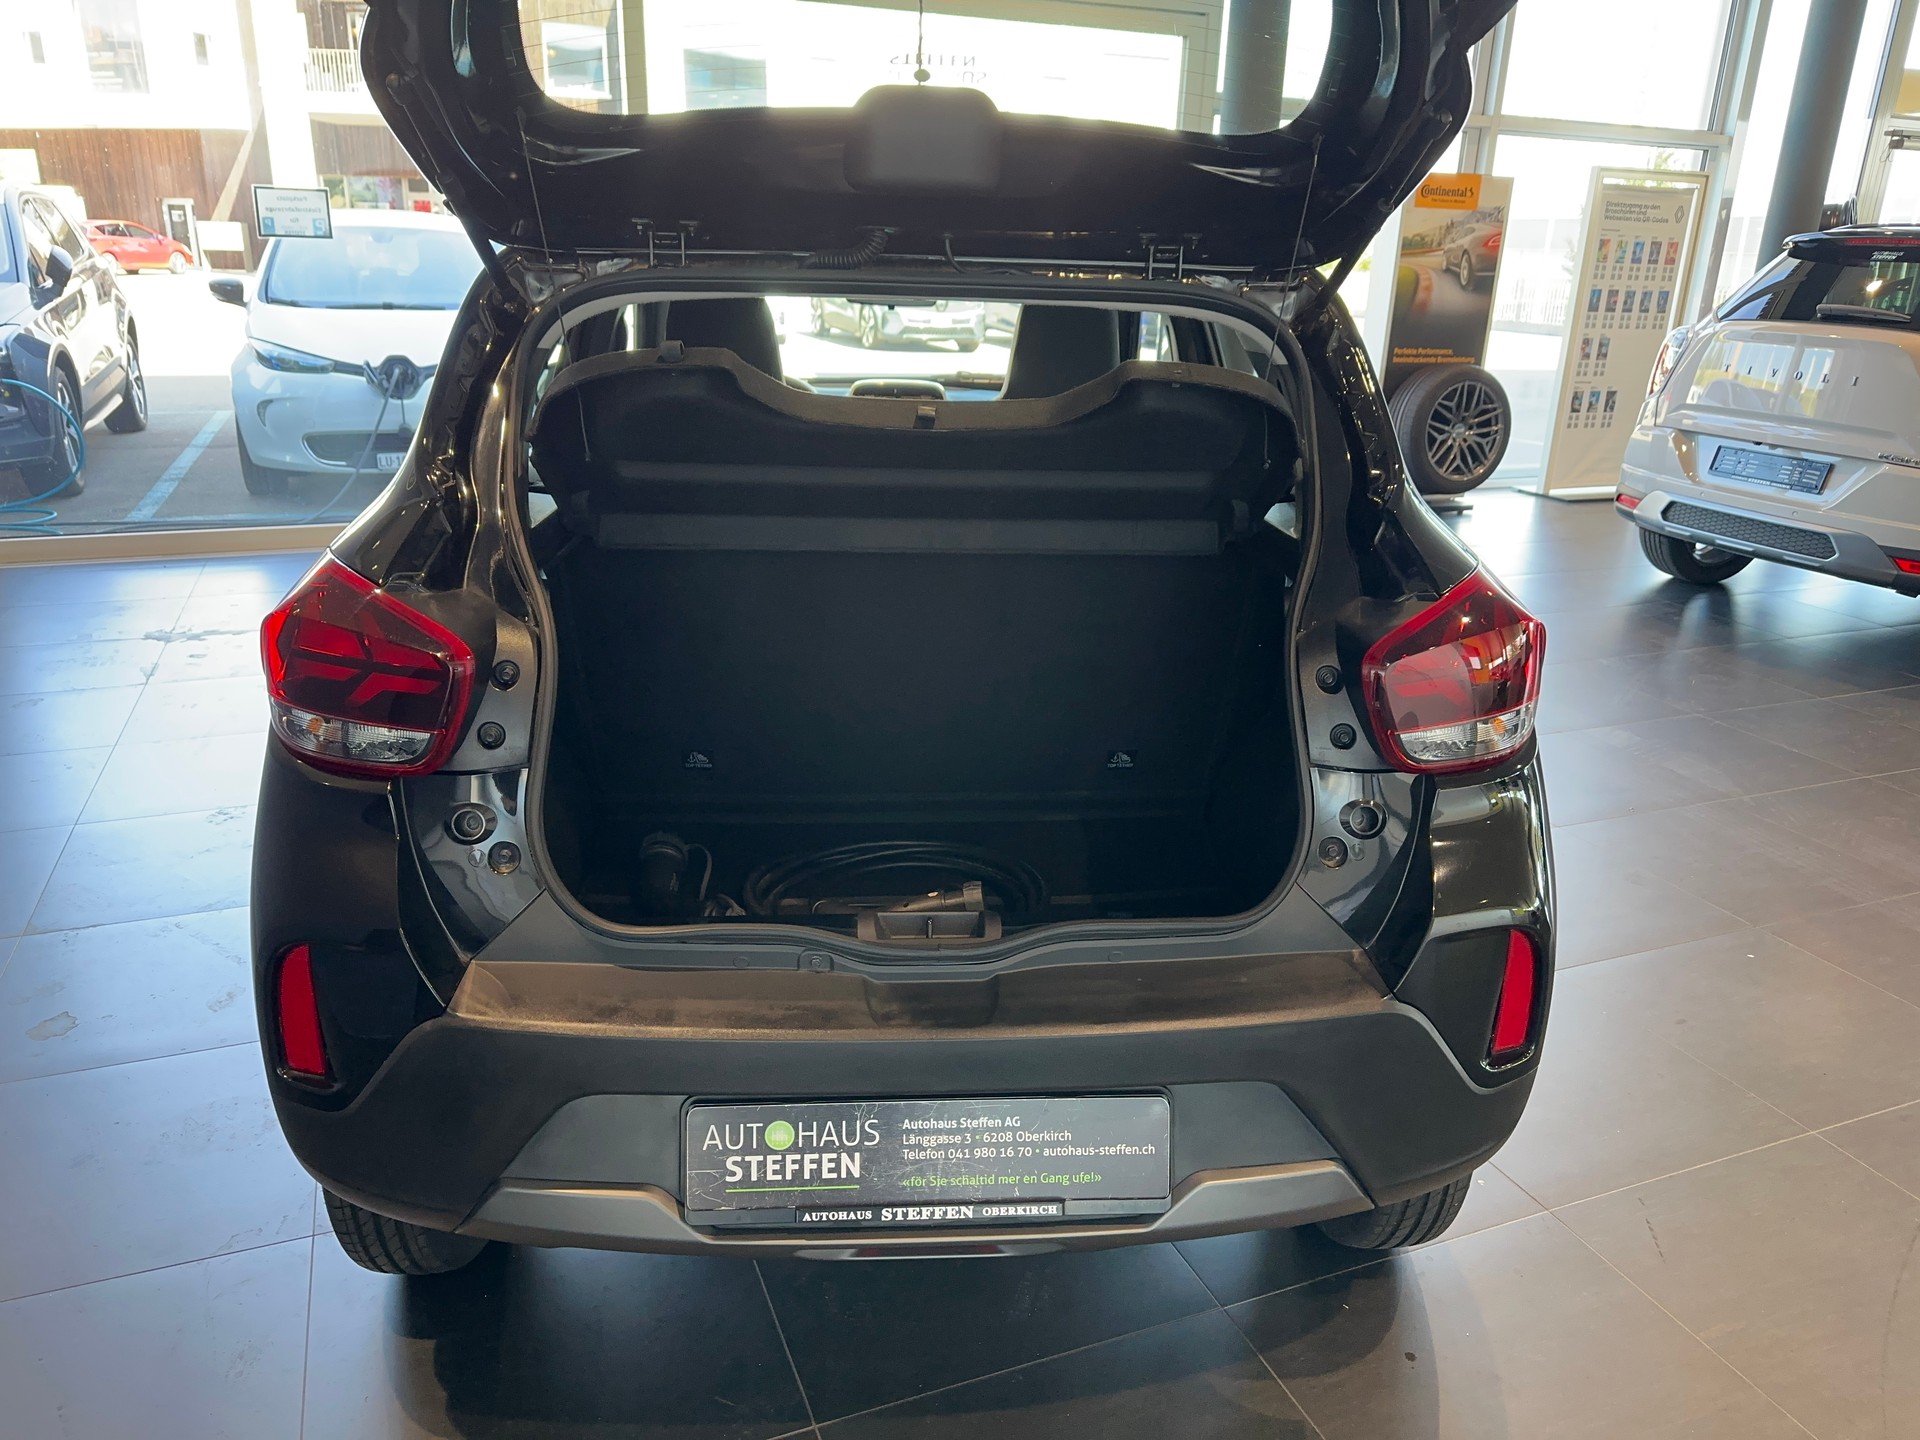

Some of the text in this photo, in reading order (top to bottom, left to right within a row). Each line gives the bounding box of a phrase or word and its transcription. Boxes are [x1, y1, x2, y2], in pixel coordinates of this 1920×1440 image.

[1421, 185, 1467, 198] Continental
[1605, 201, 1643, 210] Direktzugang
[1724, 363, 1860, 387] TIVOLI
[903, 1116, 1021, 1130] Autohaus Steffen AG
[903, 1131, 1072, 1147] Länggasse 3 6208 Oberkirch
[903, 1144, 1156, 1160] Telefon 041 980 16 70 autohaus-steffen.ch
[725, 1152, 861, 1183] STEFFEN
[903, 1172, 1102, 1187] «för Sie schaltid mer en Gang ufe!»
[803, 1205, 1057, 1221] AUTOHAUS STEFFEN OBERKIRCH
